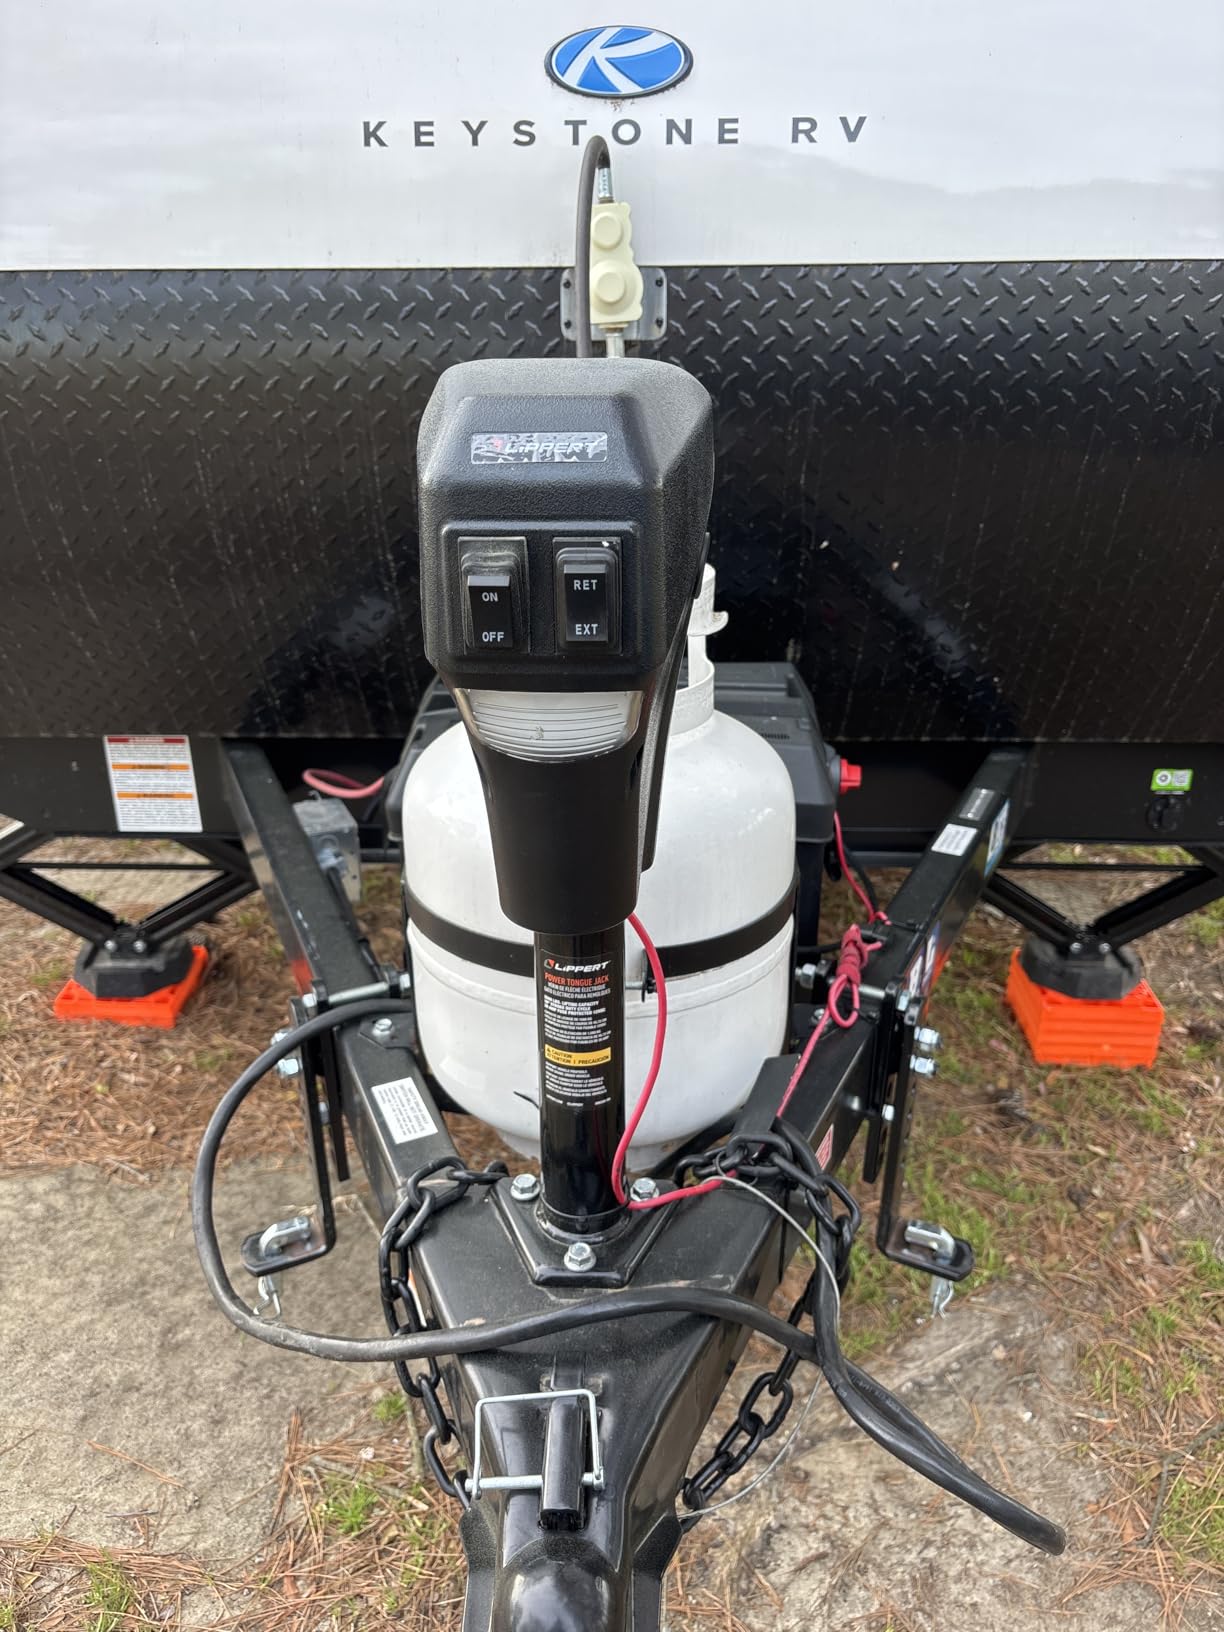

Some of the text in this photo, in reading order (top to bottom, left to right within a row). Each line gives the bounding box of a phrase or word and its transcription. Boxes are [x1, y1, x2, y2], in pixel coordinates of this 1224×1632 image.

[362, 115, 868, 147] KEYSTONE RV
[573, 580, 598, 591] RET
[481, 592, 499, 602] ON
[575, 624, 599, 635] EXT
[481, 631, 505, 643] OFF
[544, 973, 566, 984] POWER
[567, 978, 592, 986] TONGUE
[595, 975, 609, 984] JACK
